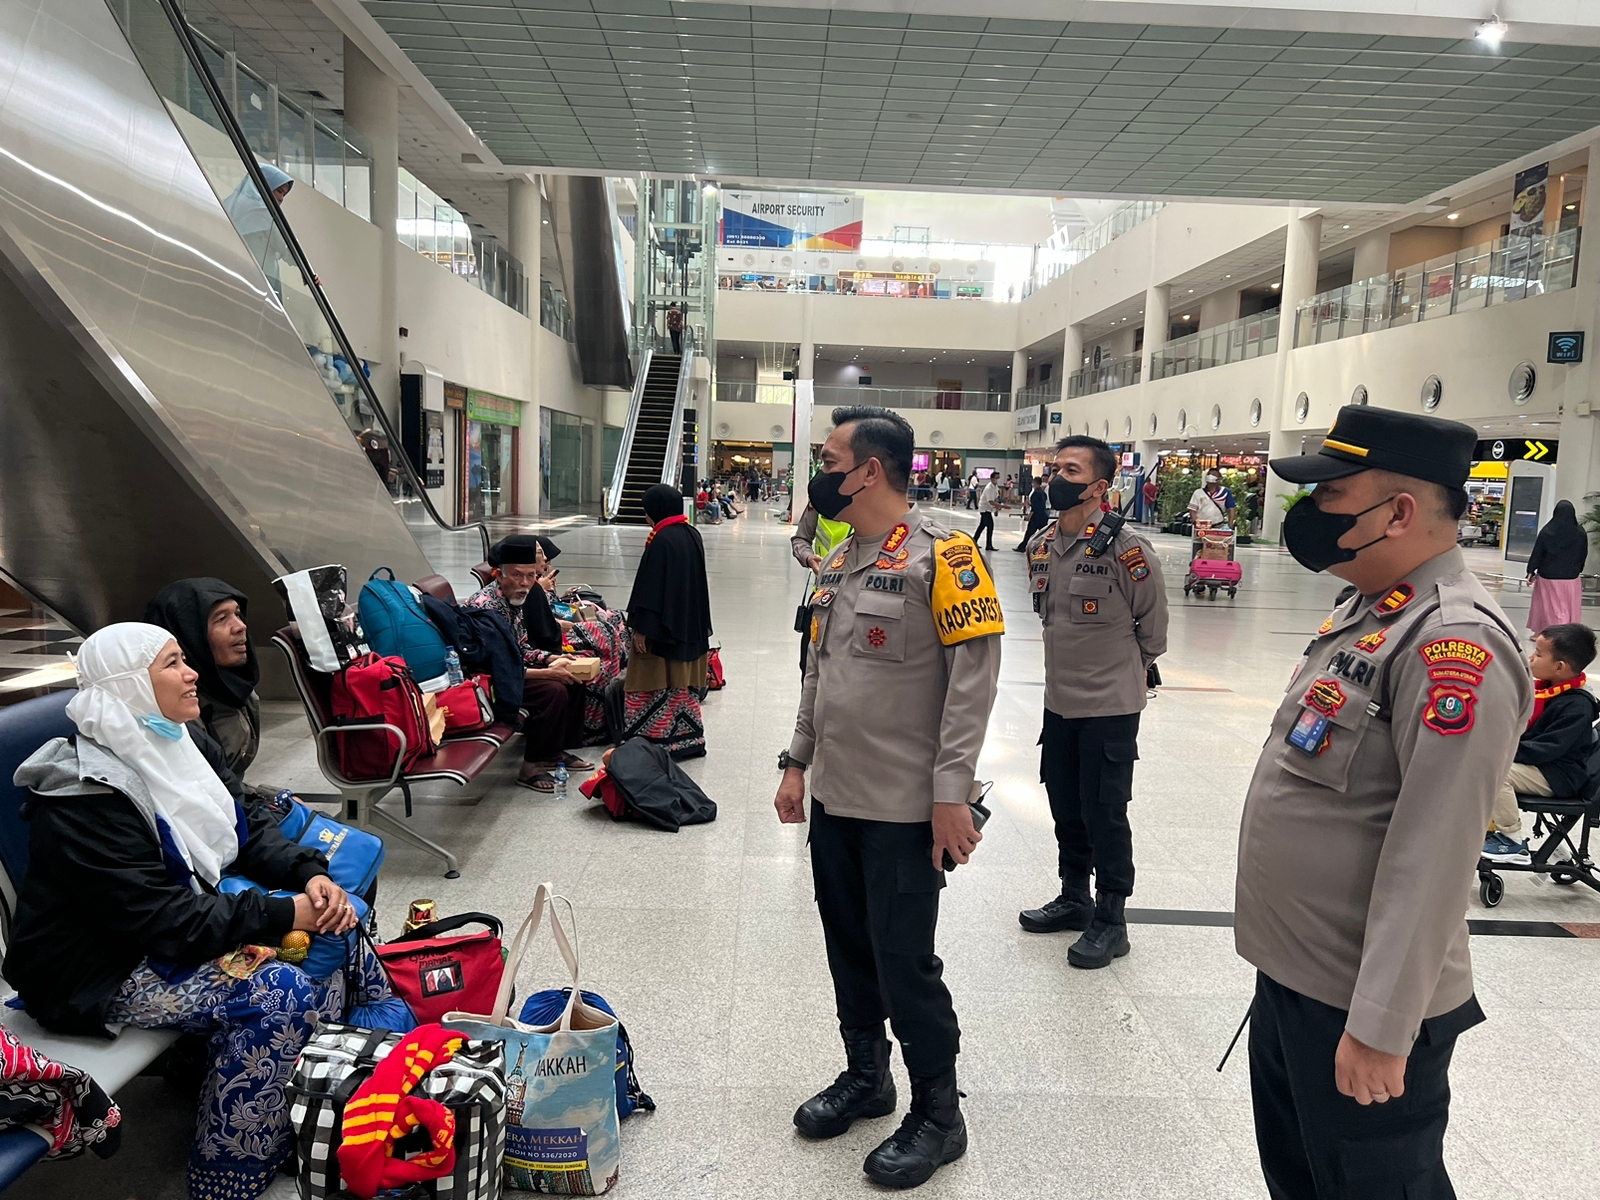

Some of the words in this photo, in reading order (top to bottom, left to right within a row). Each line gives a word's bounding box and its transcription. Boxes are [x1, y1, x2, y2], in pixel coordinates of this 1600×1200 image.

[752, 203, 785, 215] AIRPORT
[787, 204, 825, 217] SECURITY
[1076, 563, 1109, 575] POLRI
[865, 575, 904, 592] POLRI
[1424, 641, 1486, 661] POLRESTA
[1429, 652, 1446, 662] DELI
[1446, 651, 1482, 666] SERDANG
[506, 1132, 527, 1144] ERA
[529, 1135, 583, 1145] MEKKAH
[512, 1143, 542, 1151] TRAVEL
